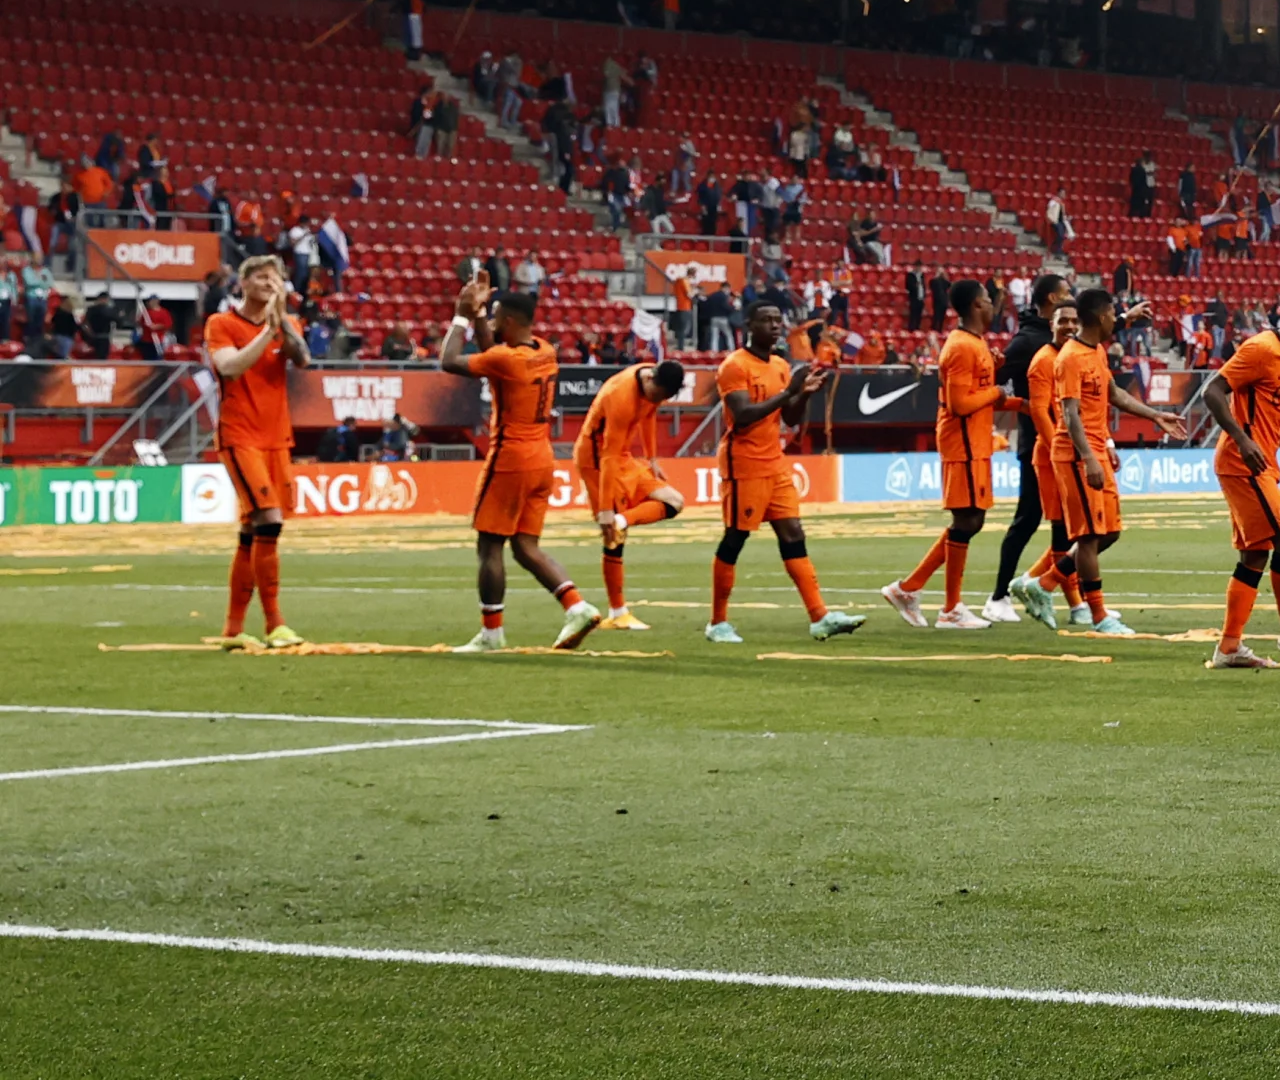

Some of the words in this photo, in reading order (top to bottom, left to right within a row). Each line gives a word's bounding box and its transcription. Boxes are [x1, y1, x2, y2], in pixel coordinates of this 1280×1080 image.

[559, 380, 587, 395] ING
[332, 398, 396, 421] WAVE
[1149, 457, 1210, 484] Albert
[49, 480, 138, 525] TOTO
[294, 474, 361, 514] NG
